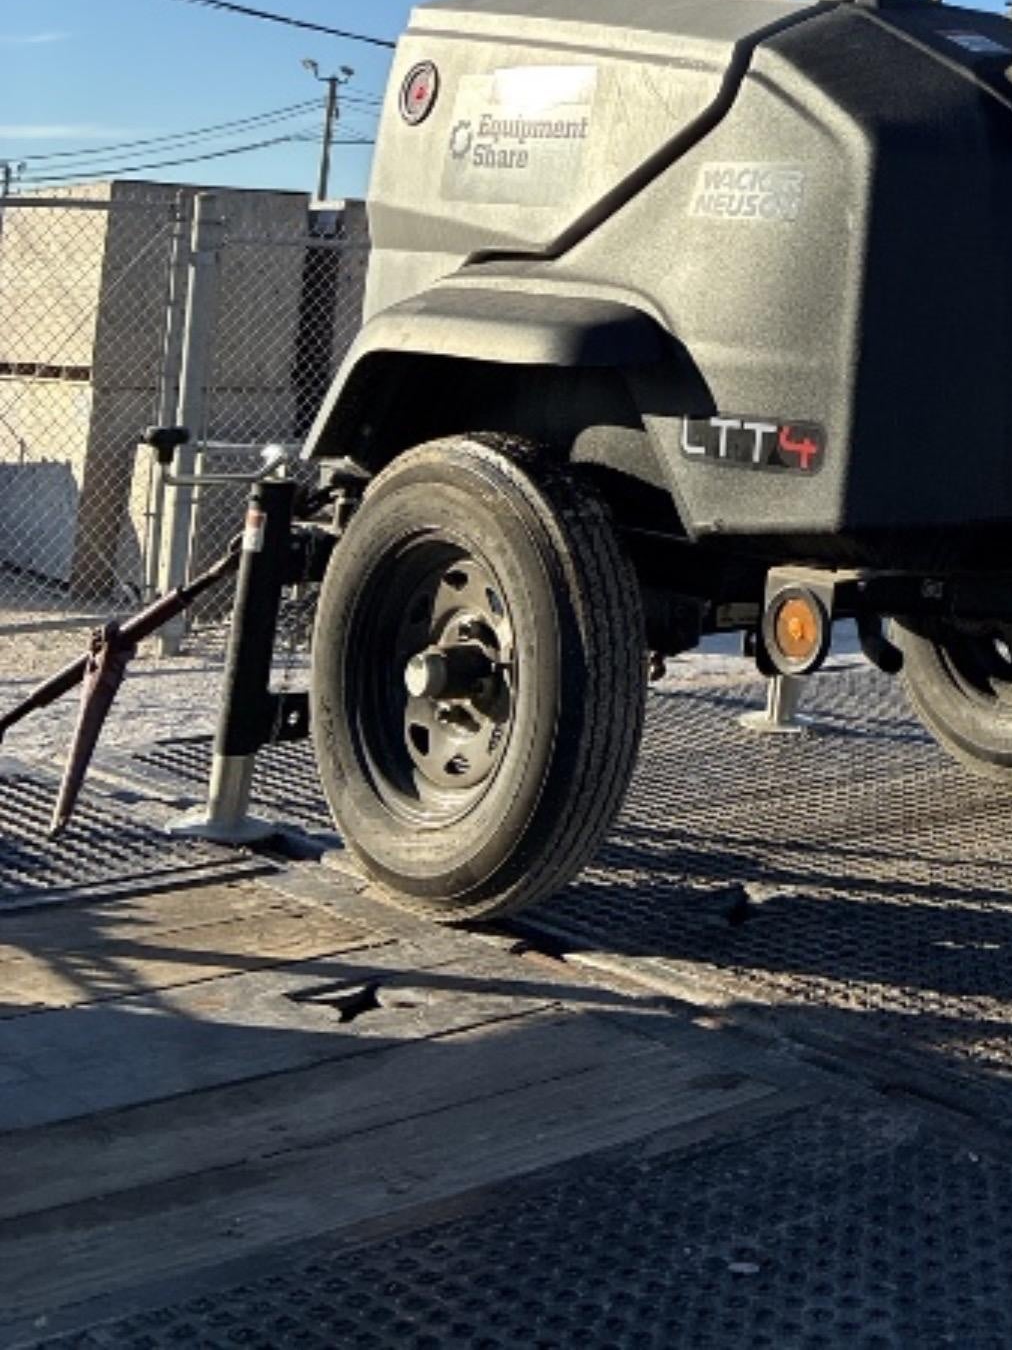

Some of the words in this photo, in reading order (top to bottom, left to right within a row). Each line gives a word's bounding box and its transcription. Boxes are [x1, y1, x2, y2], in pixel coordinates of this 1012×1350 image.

[477, 114, 589, 144] Equipment
[473, 144, 529, 168] Share
[681, 415, 818, 470] LTT4
